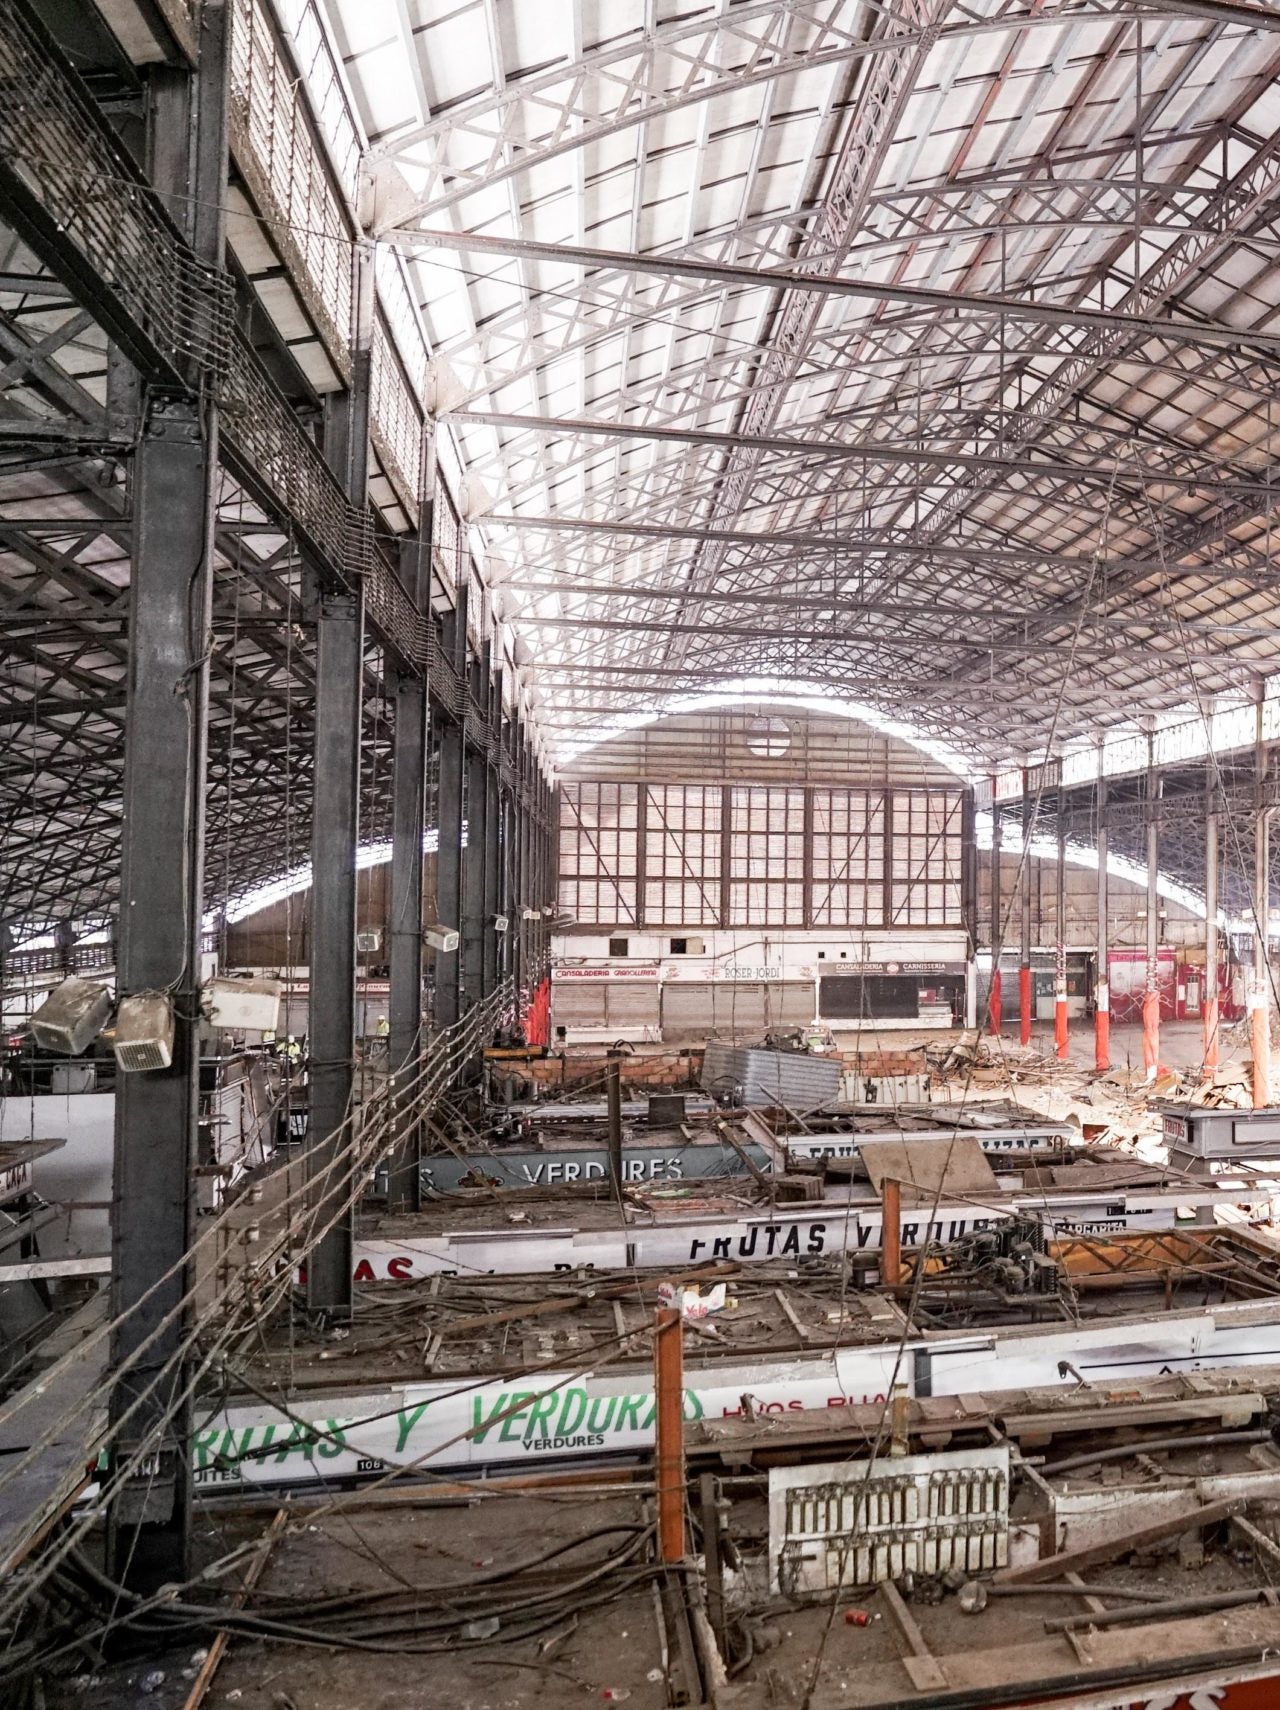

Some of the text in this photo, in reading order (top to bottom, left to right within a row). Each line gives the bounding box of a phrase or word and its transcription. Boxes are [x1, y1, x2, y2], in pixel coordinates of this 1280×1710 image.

[725, 967, 752, 979] ROSER
[756, 967, 780, 979] JORDI
[396, 1402, 430, 1453] Y
[522, 1433, 605, 1451] VERDURES
